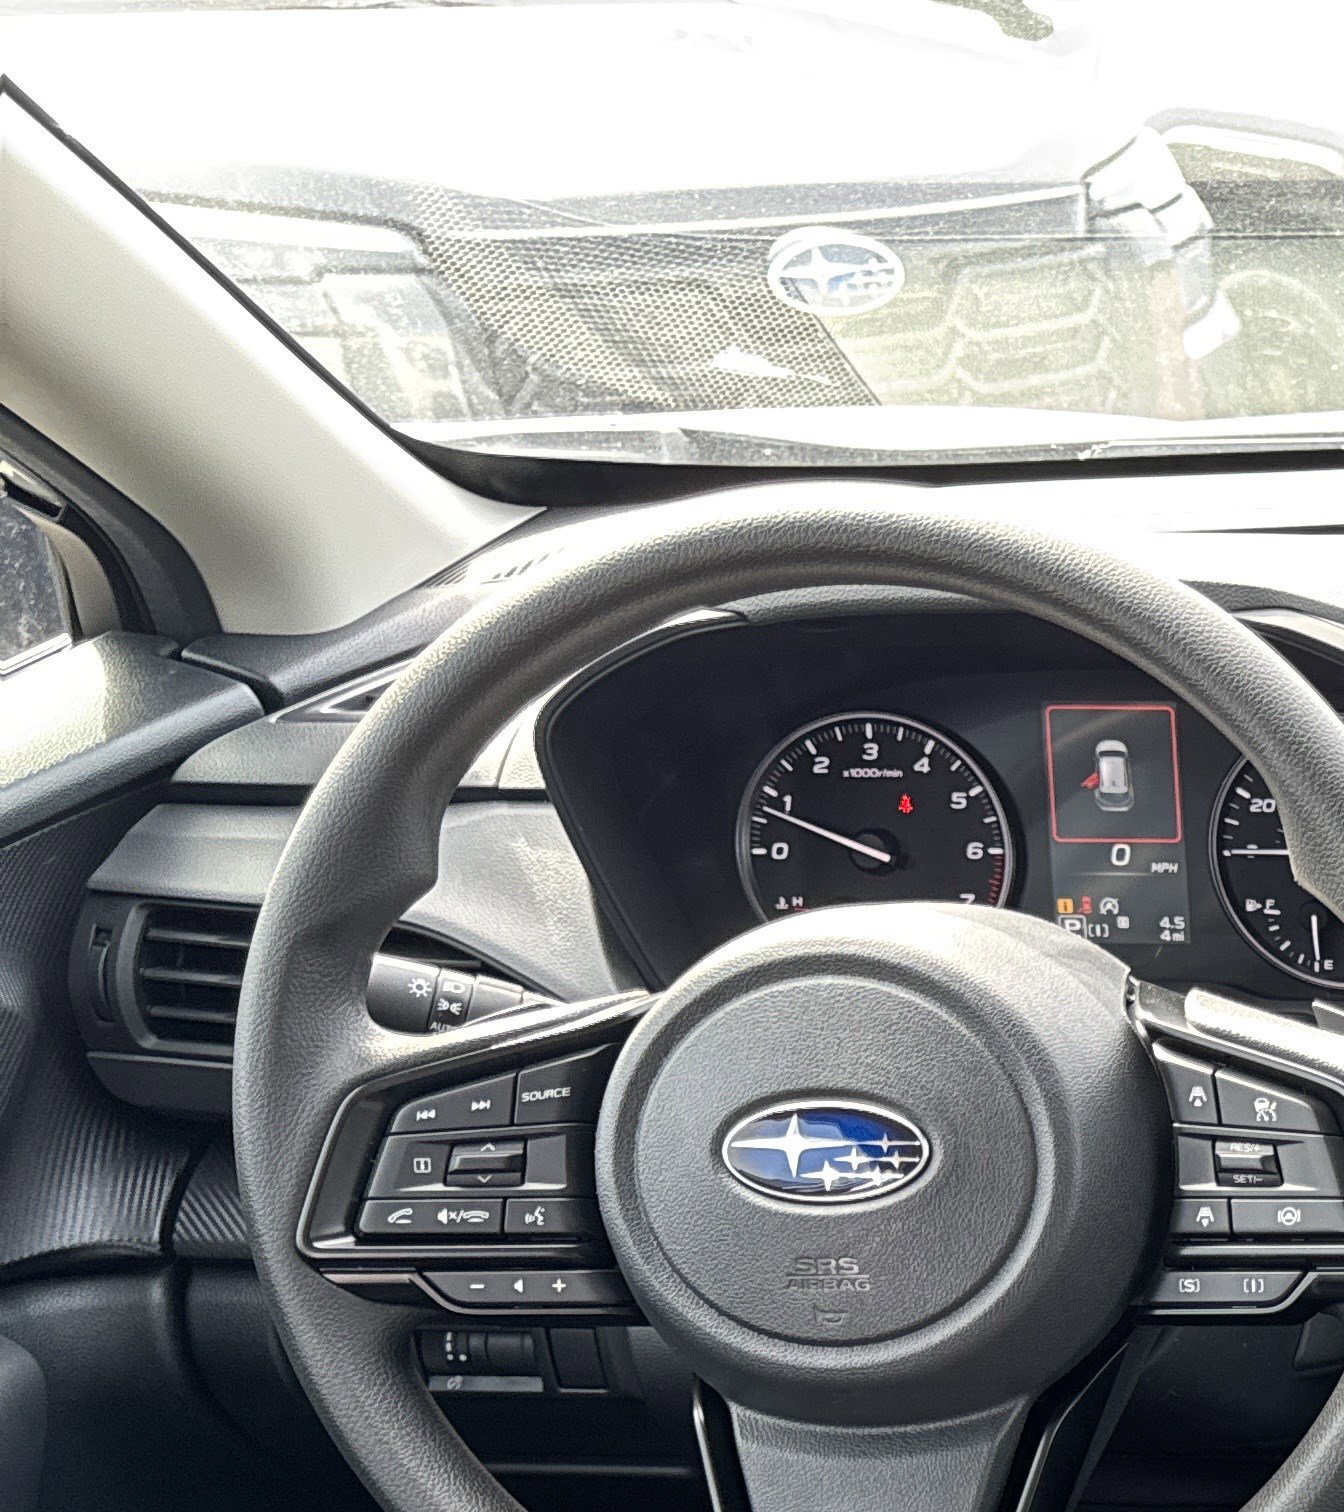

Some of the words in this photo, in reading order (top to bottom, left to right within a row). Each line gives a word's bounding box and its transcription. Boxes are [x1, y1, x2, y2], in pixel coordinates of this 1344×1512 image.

[862, 743, 879, 760] 3
[813, 757, 830, 774] 2
[914, 757, 930, 773] 4
[783, 795, 792, 812] 1
[951, 792, 967, 809] 5
[1250, 799, 1276, 813] 20
[771, 843, 789, 860] 0
[966, 842, 984, 859] 6
[1111, 844, 1130, 866] 0
[1151, 862, 1179, 873] MPH
[1159, 916, 1185, 929] 4.5
[1323, 960, 1334, 970] E
[521, 1086, 571, 1102] SOURCE
[794, 1257, 859, 1275] SRS
[785, 1279, 871, 1292] AIRBAG
